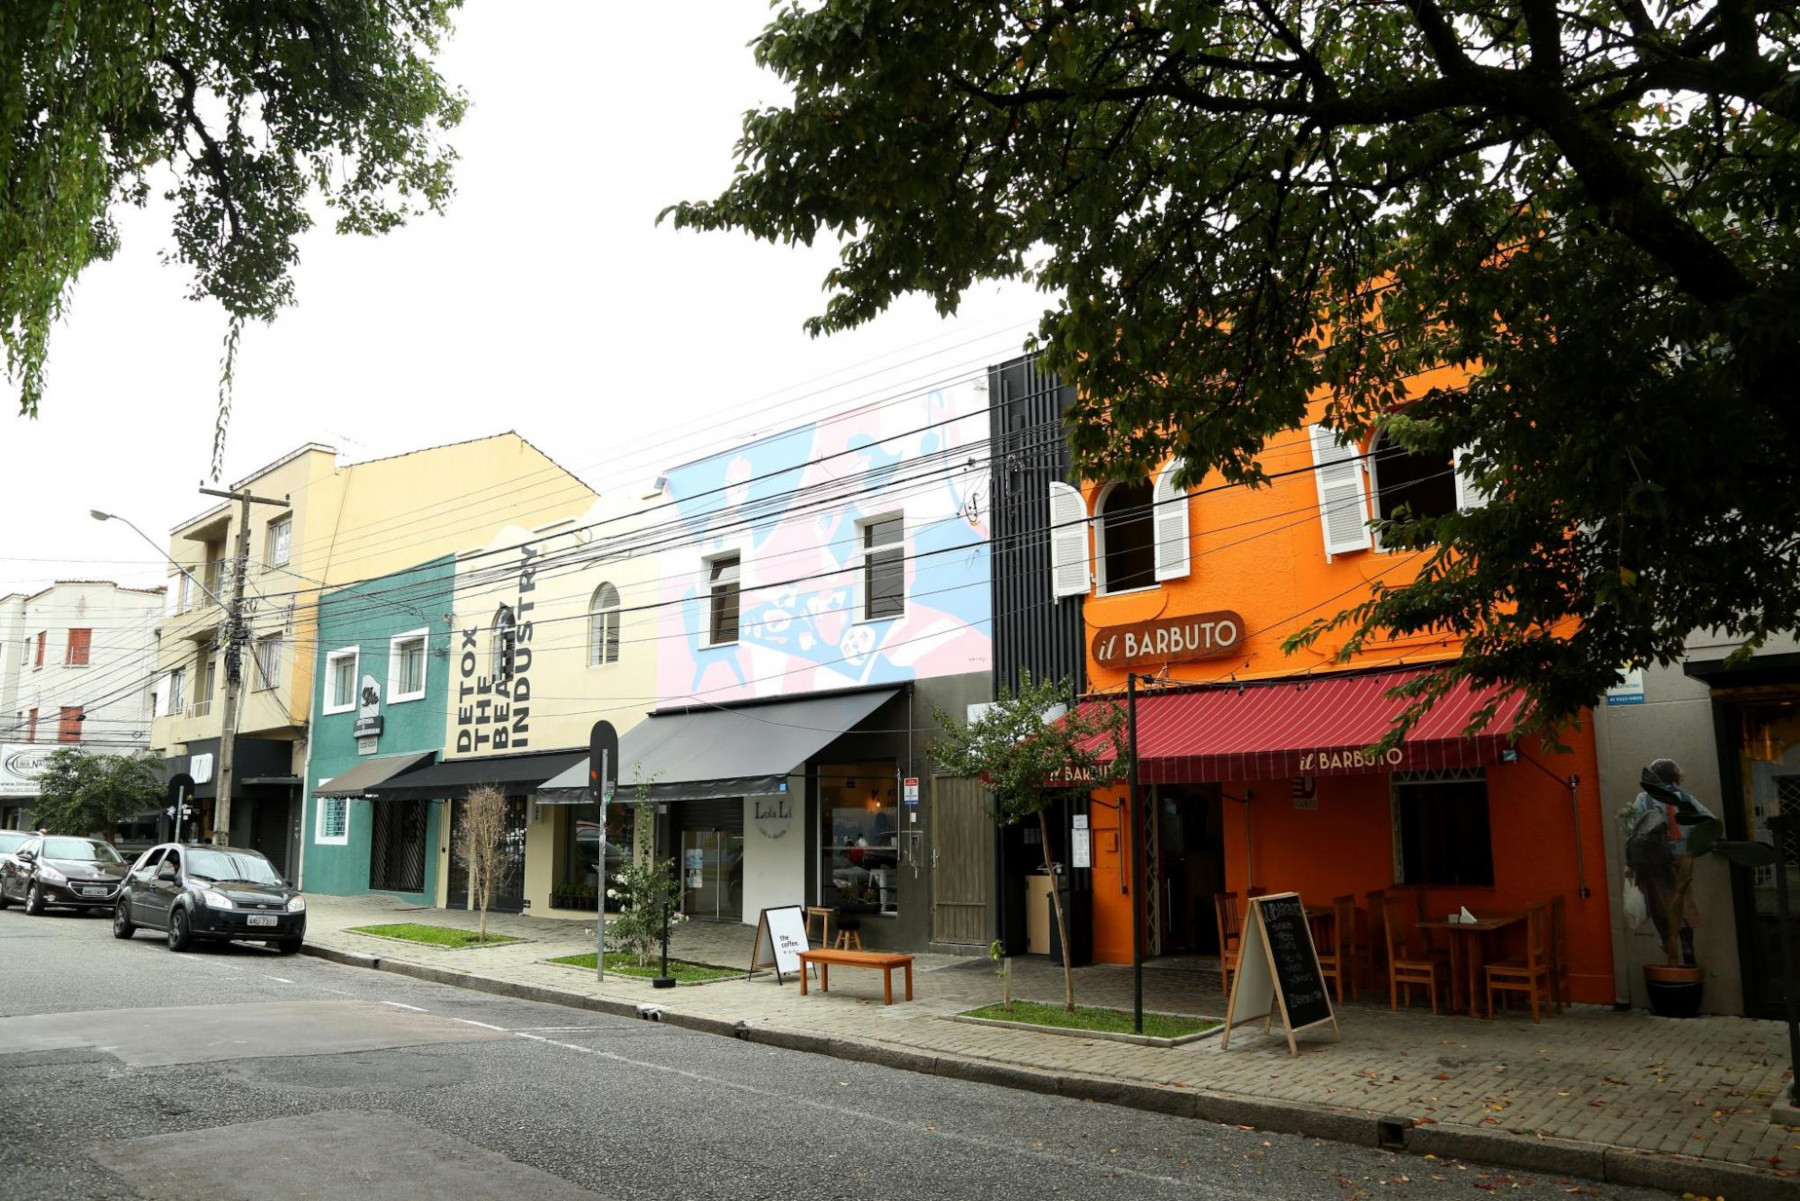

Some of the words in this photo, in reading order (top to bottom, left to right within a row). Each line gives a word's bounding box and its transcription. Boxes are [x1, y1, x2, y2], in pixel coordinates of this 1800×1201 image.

[511, 546, 538, 748] INDUSTRY
[1098, 634, 1118, 661] il
[1125, 620, 1237, 658] BARBUTO
[457, 626, 477, 753] DETOX
[474, 676, 492, 751] THE
[1299, 753, 1315, 770] il
[754, 802, 776, 819] Lola
[778, 801, 792, 818] Li
